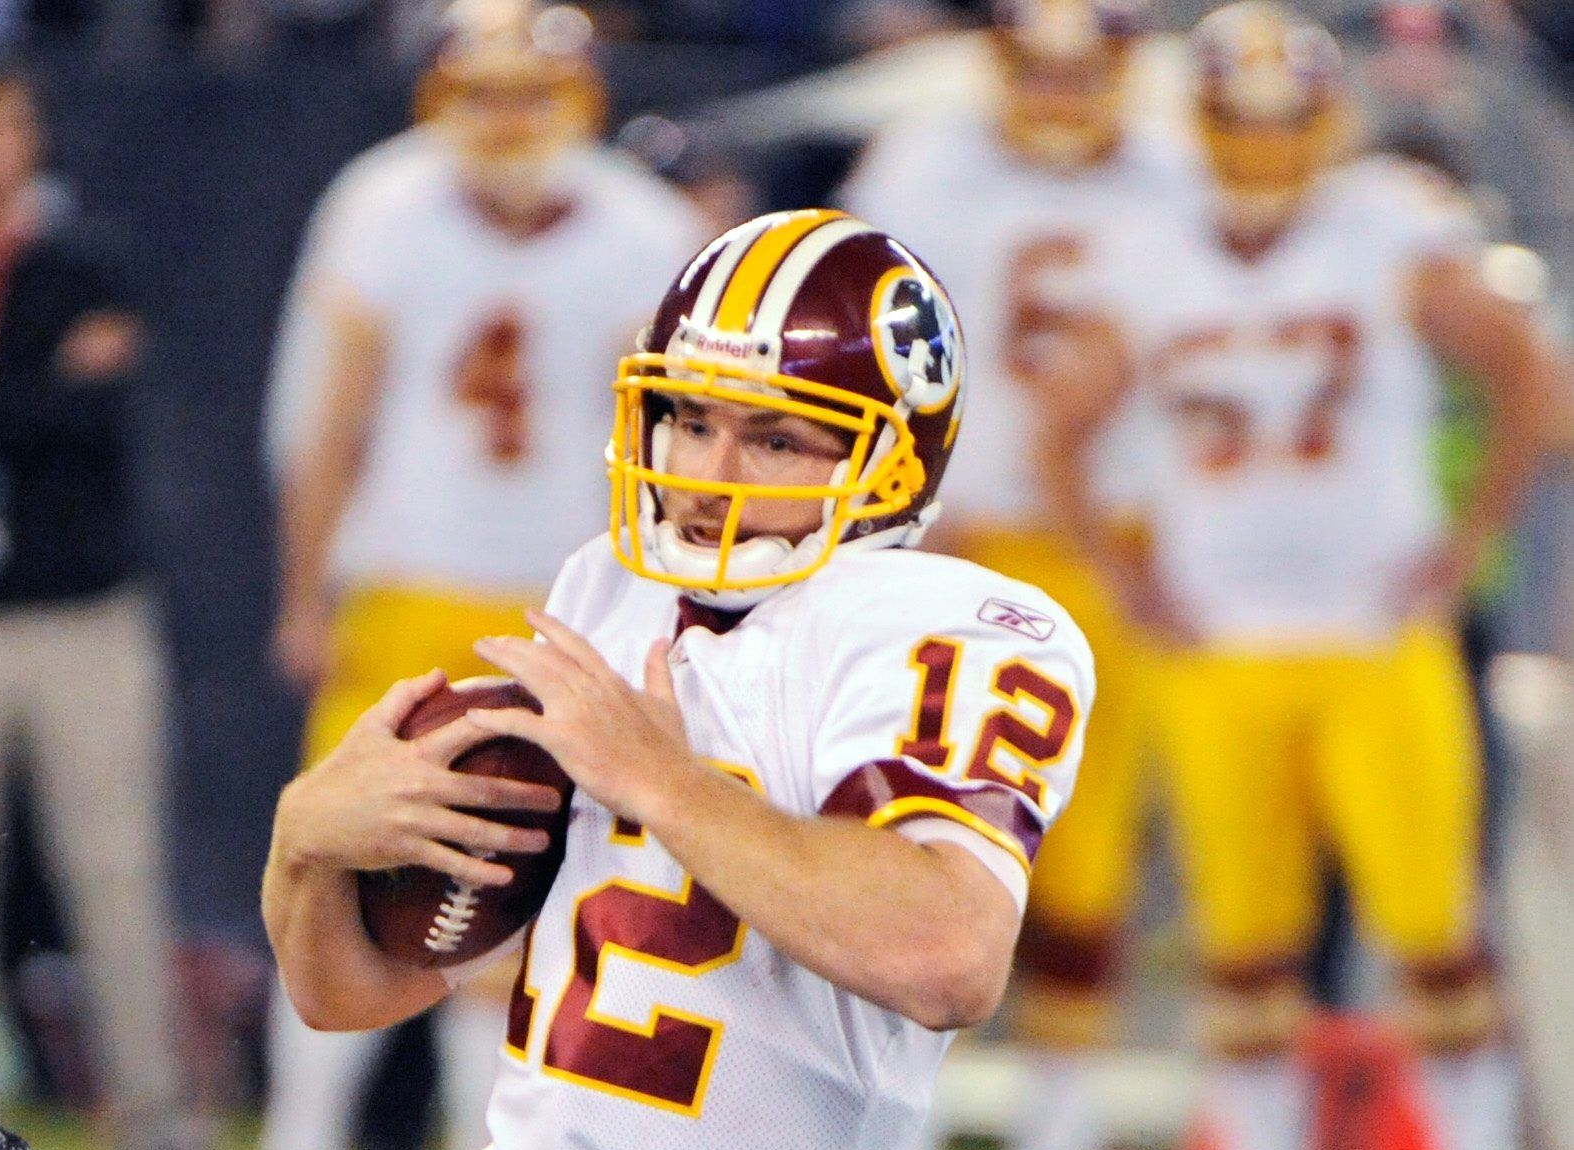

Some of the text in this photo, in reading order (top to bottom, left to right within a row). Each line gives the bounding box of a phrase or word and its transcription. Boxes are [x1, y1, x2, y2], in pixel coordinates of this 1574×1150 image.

[447, 305, 532, 464] 4
[1146, 314, 1362, 470] 57
[894, 634, 1080, 816] 12
